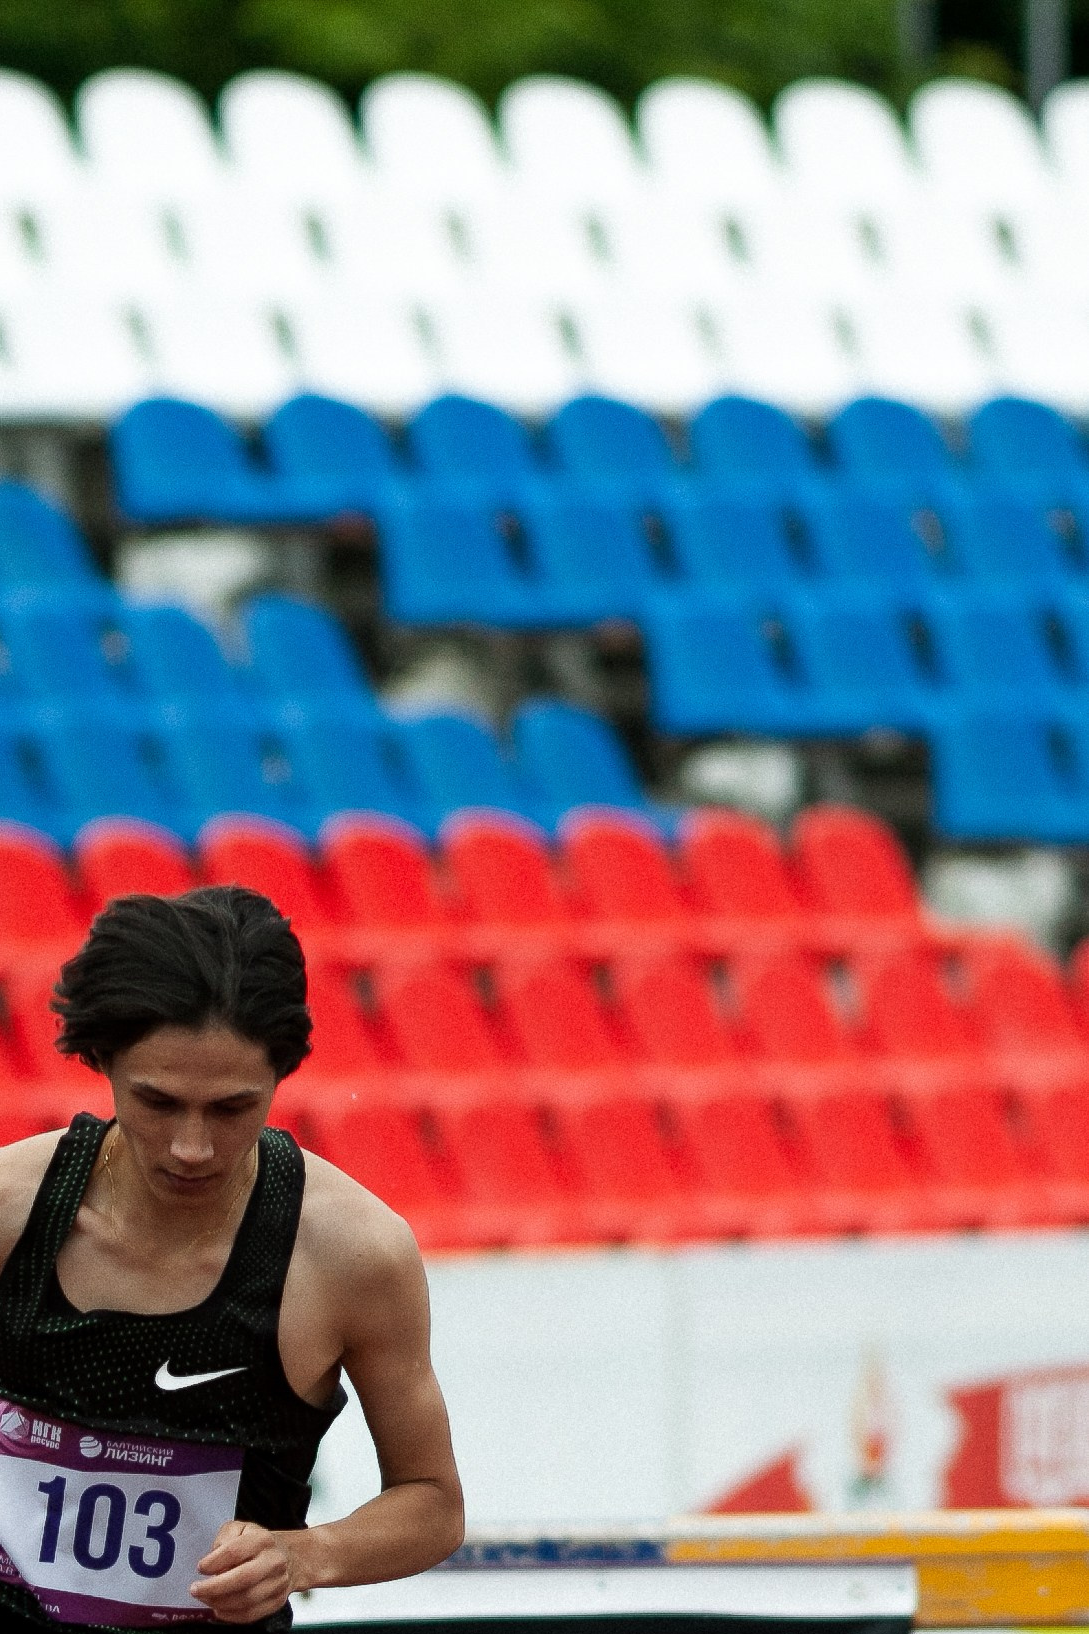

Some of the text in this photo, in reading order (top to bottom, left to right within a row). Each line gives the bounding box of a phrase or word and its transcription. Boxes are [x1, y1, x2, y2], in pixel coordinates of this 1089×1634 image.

[32, 1419, 62, 1442] НГК
[104, 1448, 173, 1468] ЛИЗИНГ
[37, 1475, 182, 1579] 103
